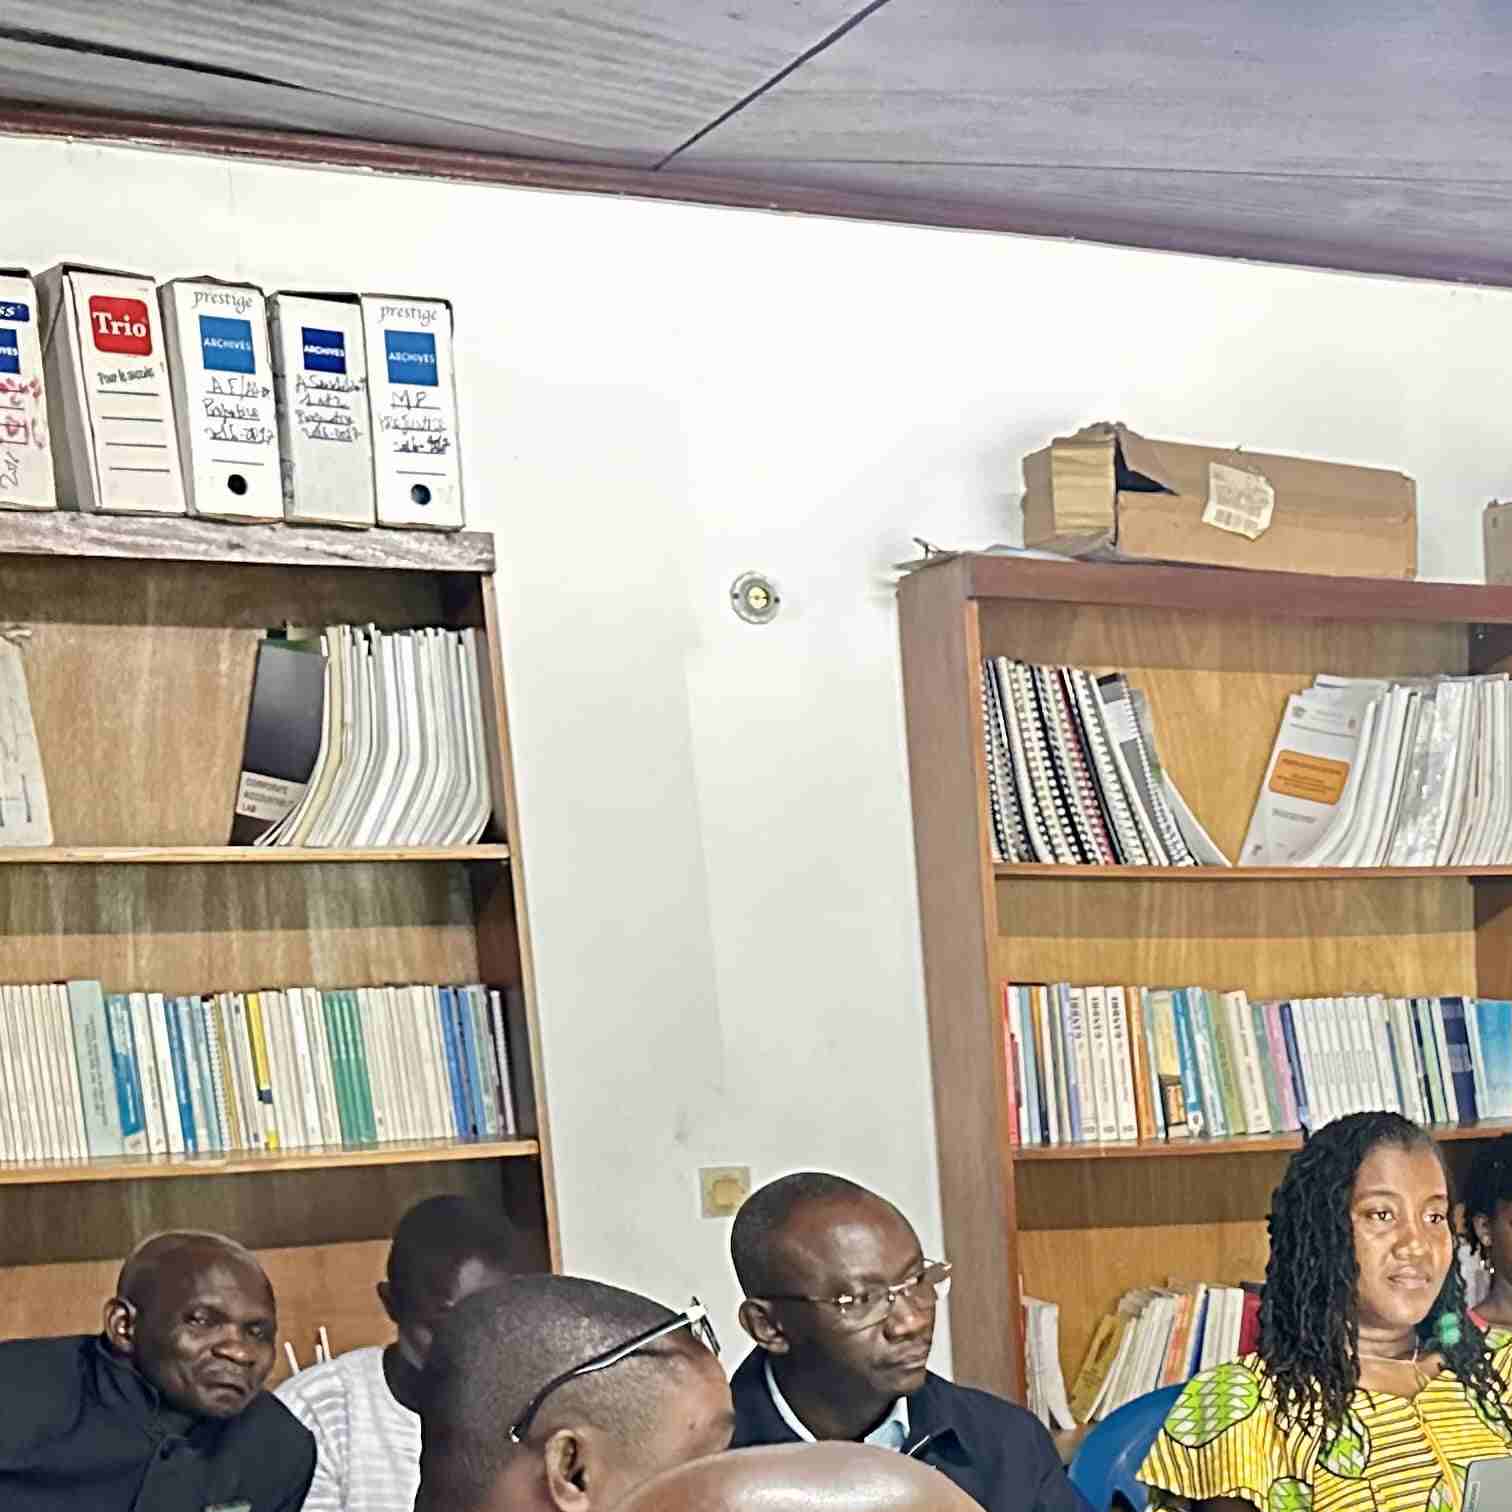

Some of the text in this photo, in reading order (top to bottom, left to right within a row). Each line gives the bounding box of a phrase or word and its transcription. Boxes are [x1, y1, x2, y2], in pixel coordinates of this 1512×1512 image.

[192, 290, 253, 313] prestige
[92, 311, 147, 338] Trio
[378, 304, 438, 327] prestige
[203, 337, 251, 351] ARCHIVES
[303, 344, 345, 358] ARCHIVES
[388, 351, 435, 365] ARCHIVES
[1070, 997, 1081, 1039] GANDHI
[1091, 997, 1102, 1039] GANDHI
[1111, 997, 1121, 1039] GANDHI
